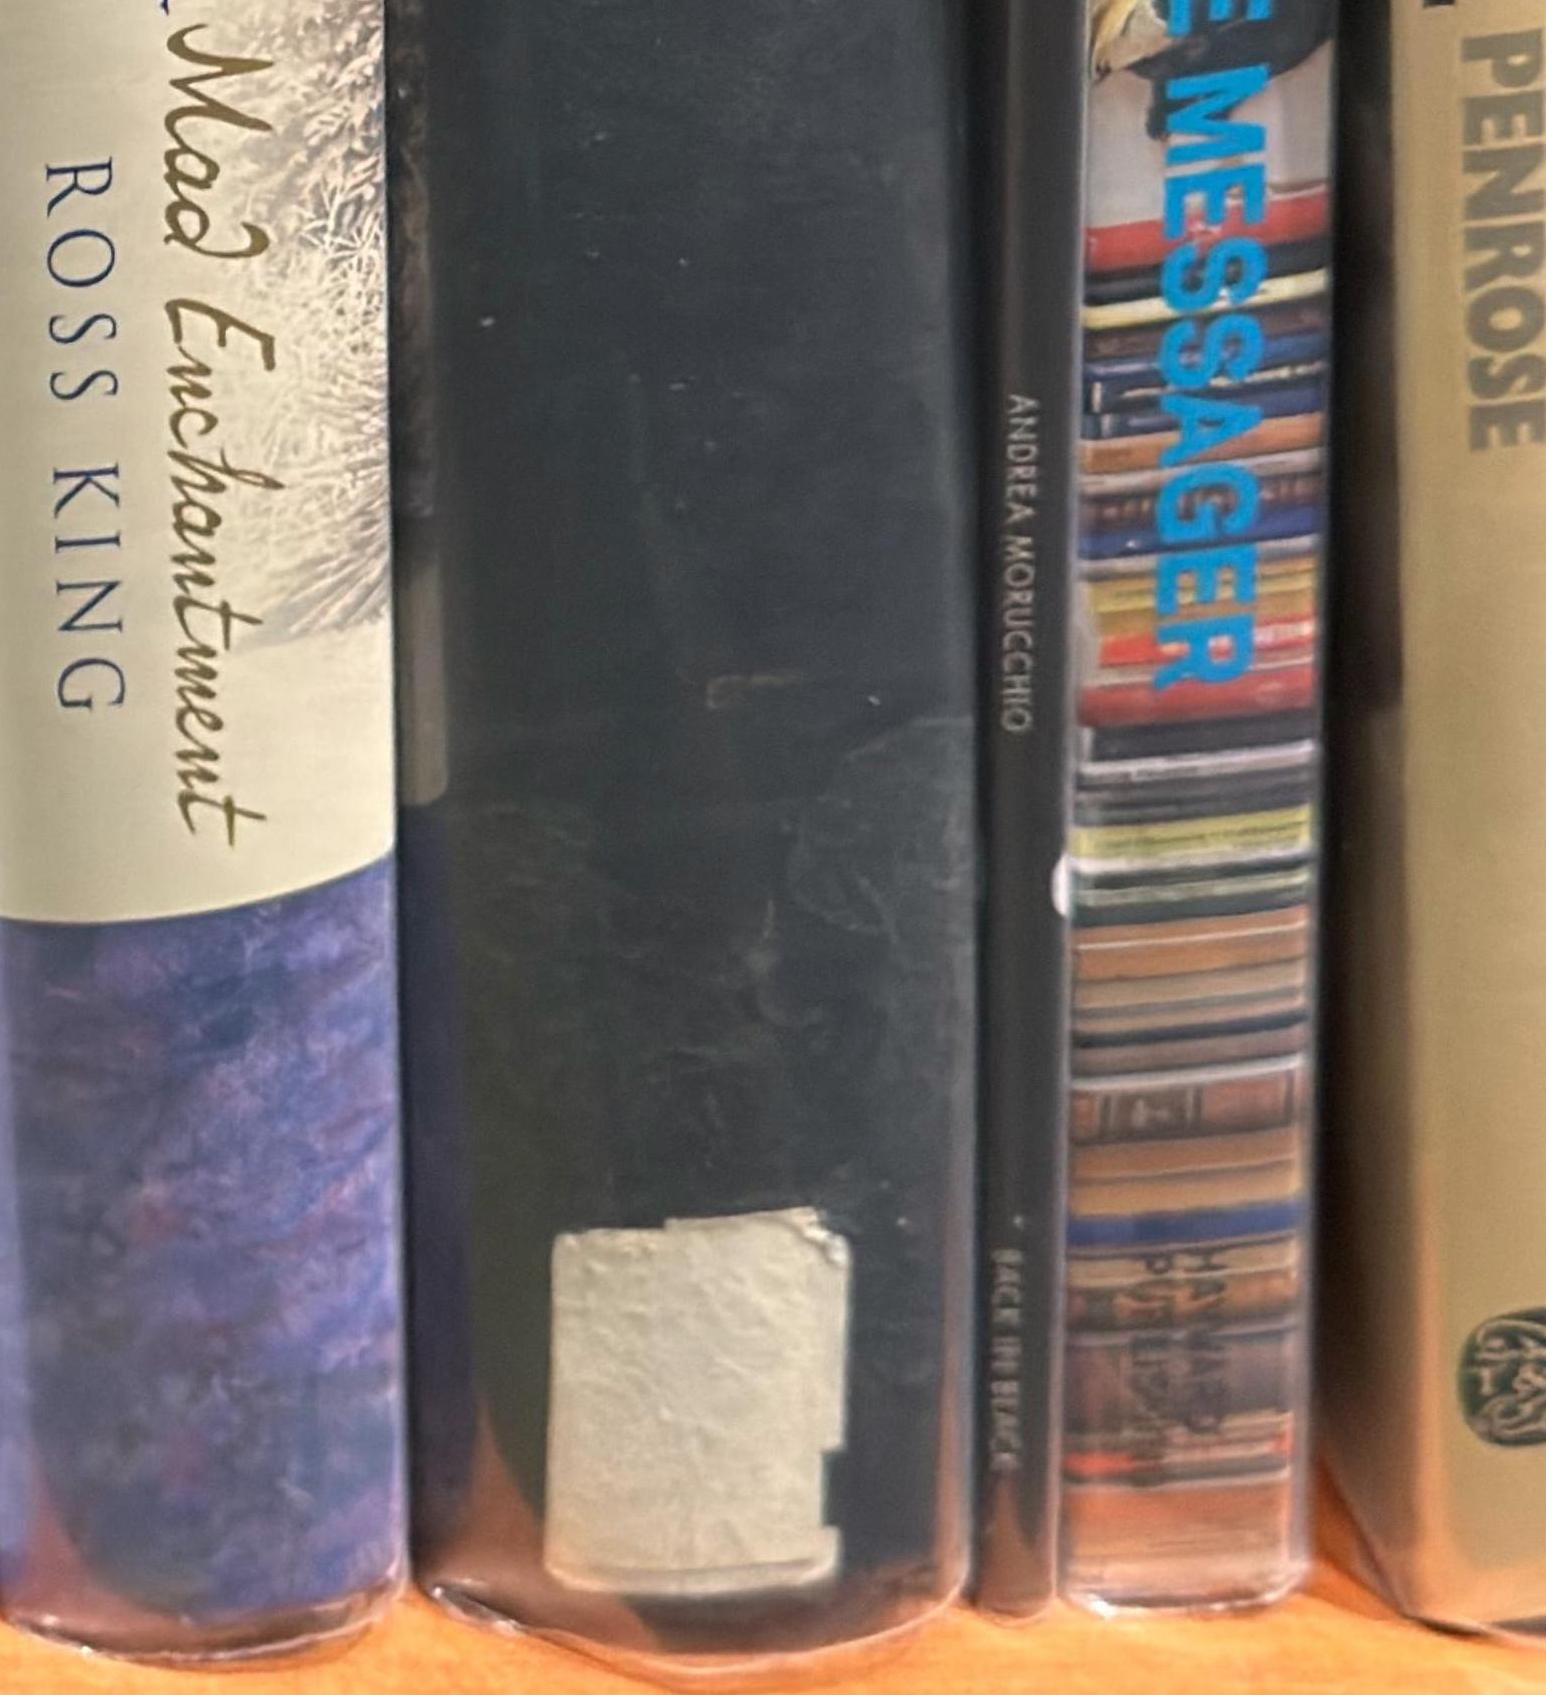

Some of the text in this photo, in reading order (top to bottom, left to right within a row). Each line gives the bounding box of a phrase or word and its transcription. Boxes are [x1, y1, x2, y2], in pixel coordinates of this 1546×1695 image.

[46, 155, 127, 714] ROSS KING
[163, 22, 287, 848] Mad Enchantment
[1000, 394, 1040, 734] ANDREA MORUCCHIO
[1152, 62, 1271, 690] MESSAGER
